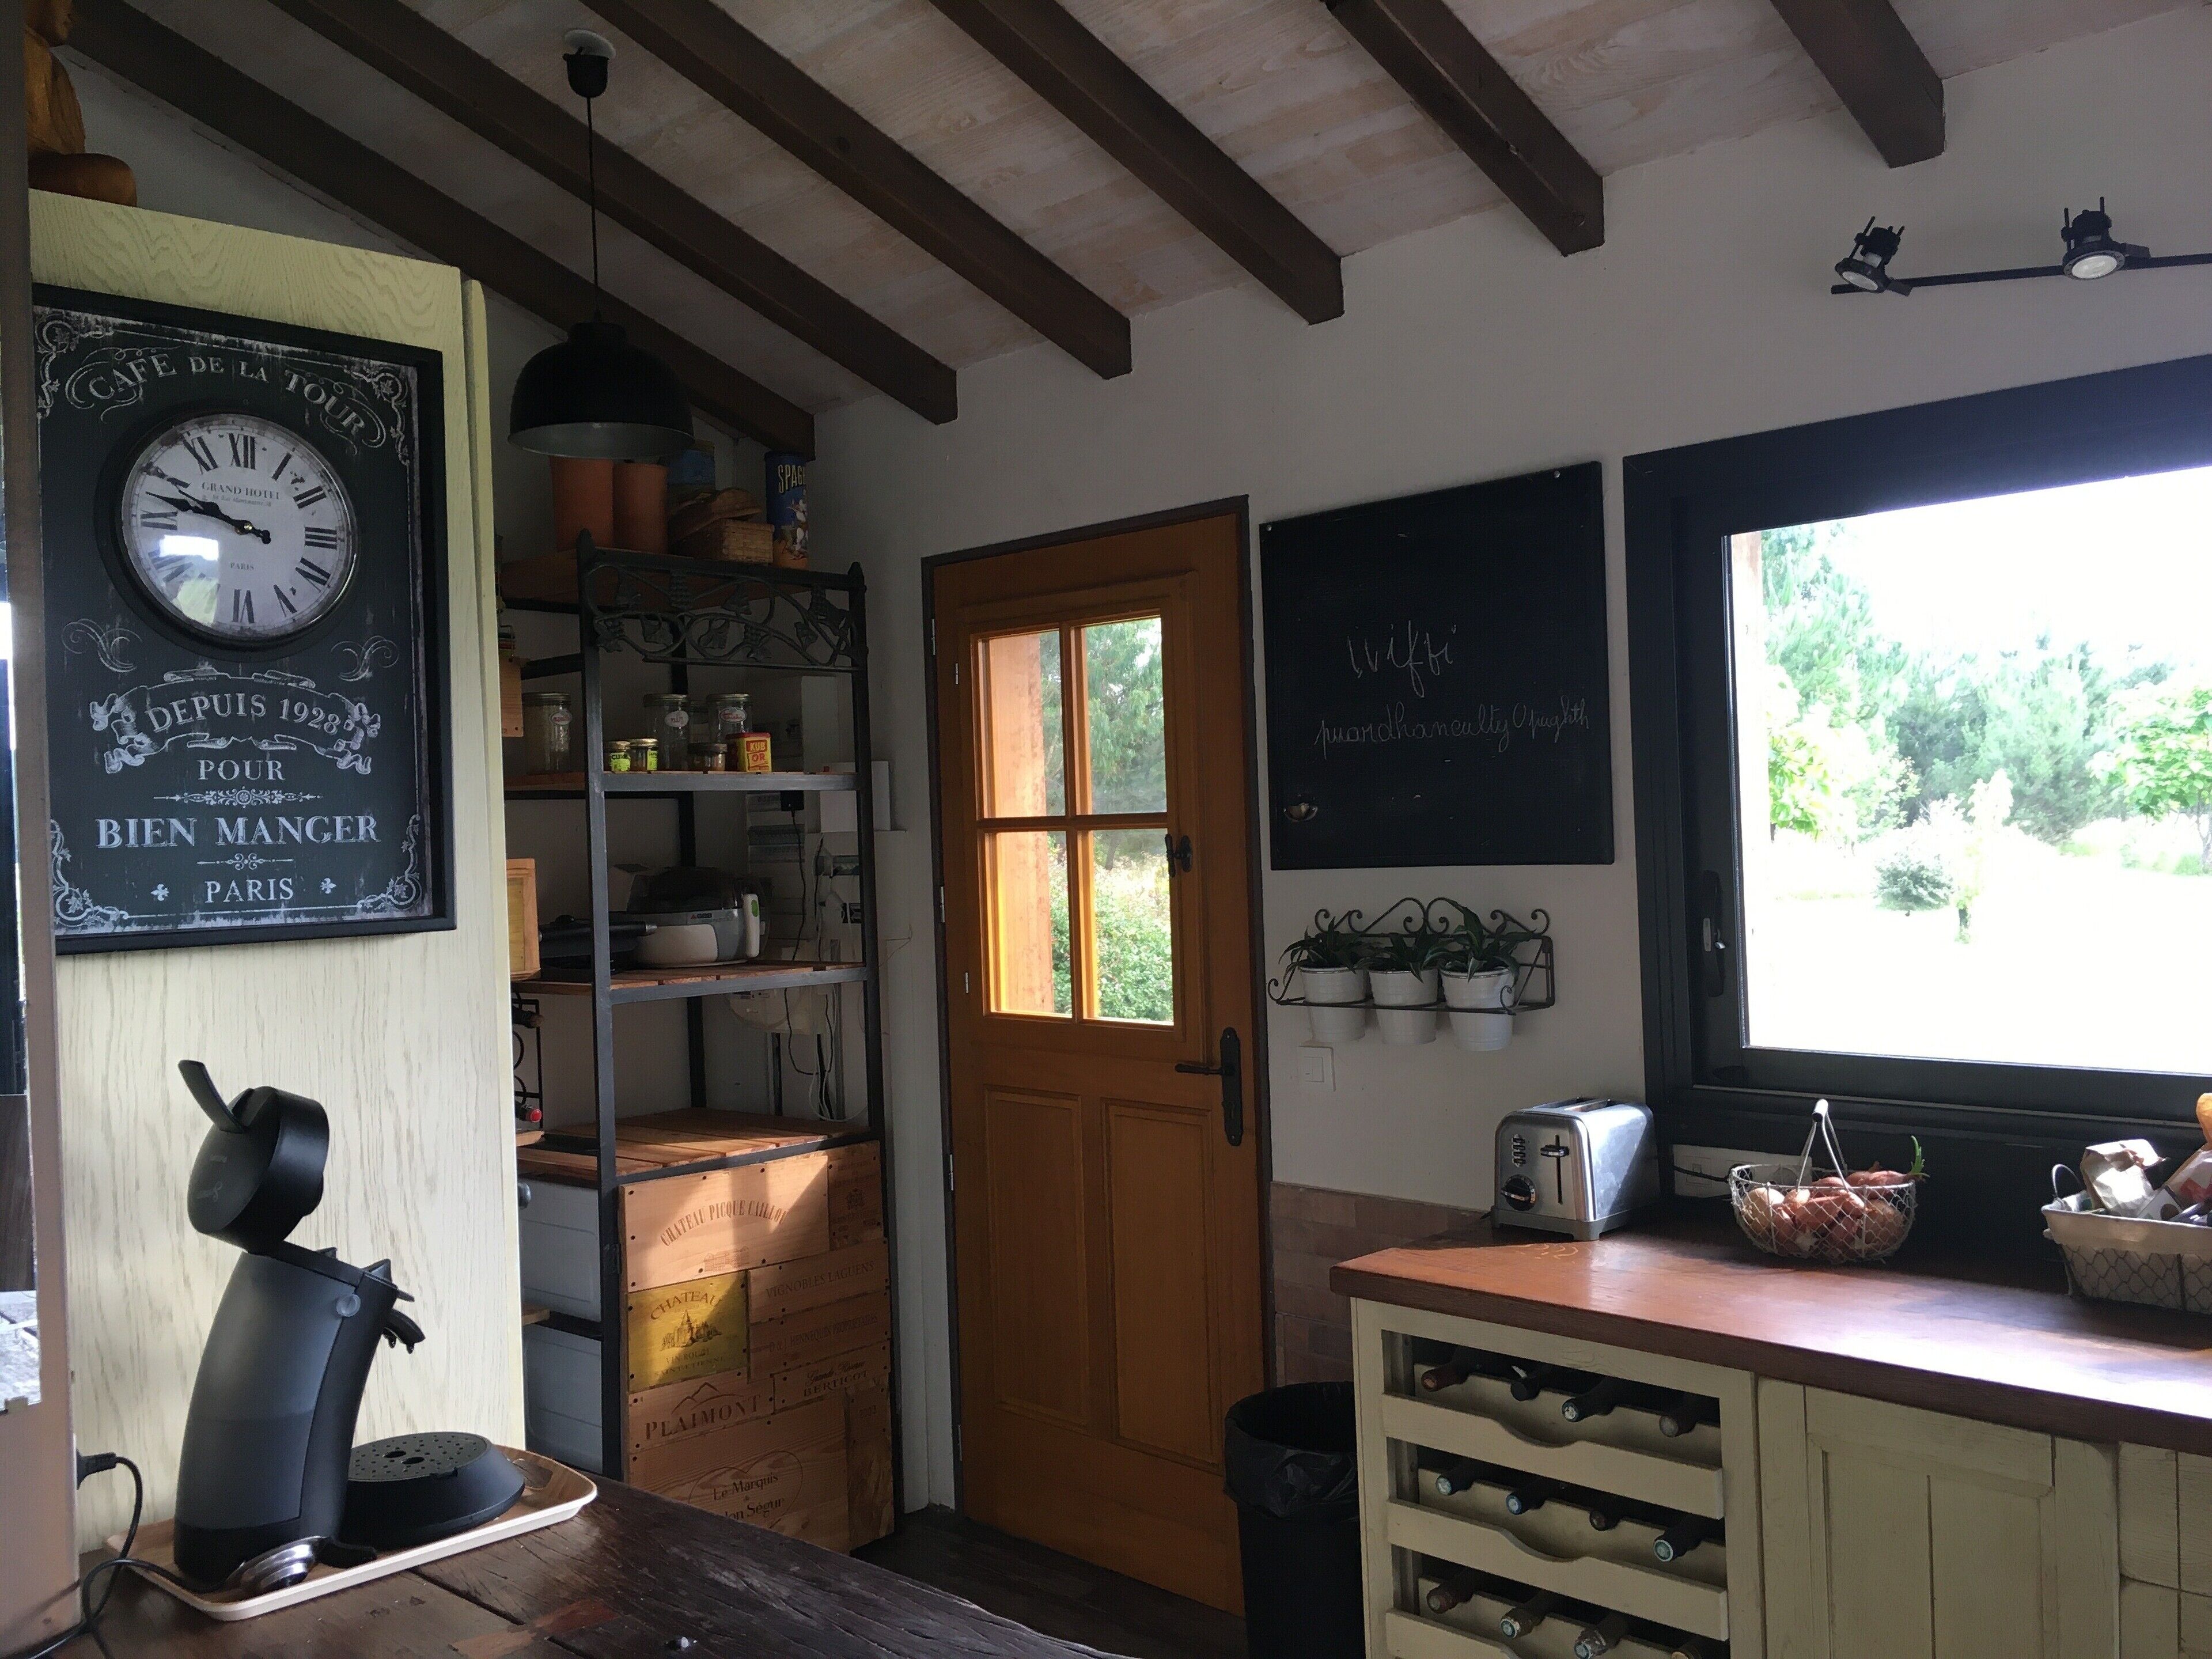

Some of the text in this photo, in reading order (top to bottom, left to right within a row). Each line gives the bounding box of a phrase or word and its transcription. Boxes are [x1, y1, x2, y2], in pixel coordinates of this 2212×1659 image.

[89, 353, 365, 435] CAFE DE LA TOUR
[229, 433, 256, 471] XII
[202, 482, 281, 500] GRAND HOTEL
[293, 486, 327, 509] II
[304, 527, 337, 550] III
[230, 562, 254, 570] PARIS
[145, 693, 341, 735] DEPUIS 1928
[750, 741, 766, 751] KUB
[752, 752, 766, 762] OR
[198, 759, 286, 781] POUR
[95, 815, 382, 849] BIEN MANGER
[204, 877, 294, 904] PARIS
[660, 1206, 706, 1247] CHATEAU
[709, 1200, 745, 1221] PICQUE
[766, 1275, 825, 1298] VIGNOBLES
[650, 1291, 722, 1320] CHATEAU
[803, 1370, 867, 1397] BERTICOT
[645, 1394, 760, 1440] PLAIMONT
[714, 1472, 778, 1501] Le Marquis
